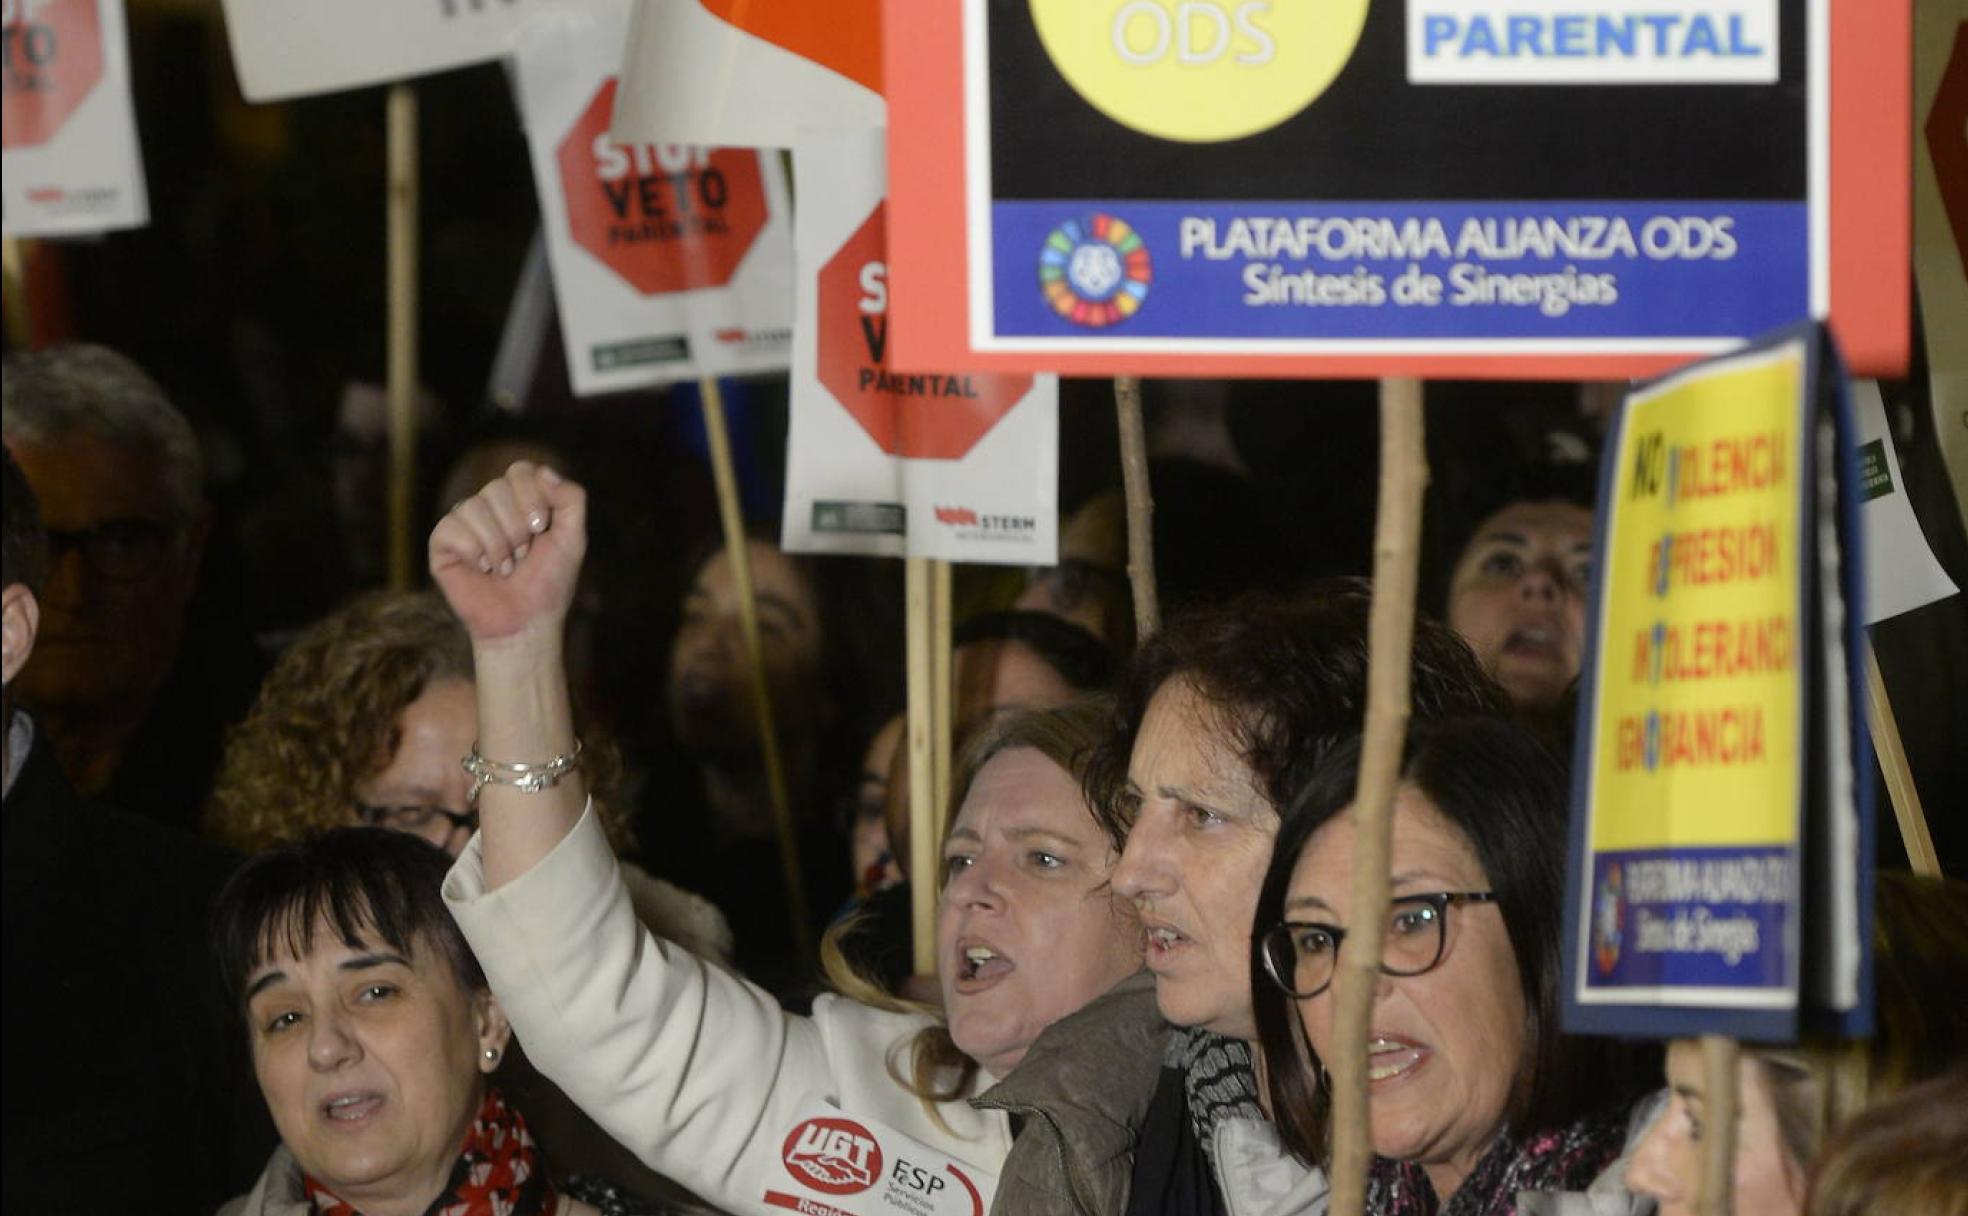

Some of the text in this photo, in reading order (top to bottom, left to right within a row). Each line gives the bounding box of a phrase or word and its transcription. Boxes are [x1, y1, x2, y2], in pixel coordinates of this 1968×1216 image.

[1110, 0, 1277, 66] ODS
[1423, 14, 1763, 57] PARENTAL
[602, 167, 728, 218] VETO
[1180, 217, 1738, 260] PLATAFORMA ALIANZA ODS
[1392, 263, 1444, 307] de
[859, 368, 977, 399] PAENTAL
[802, 1124, 874, 1168] UGT
